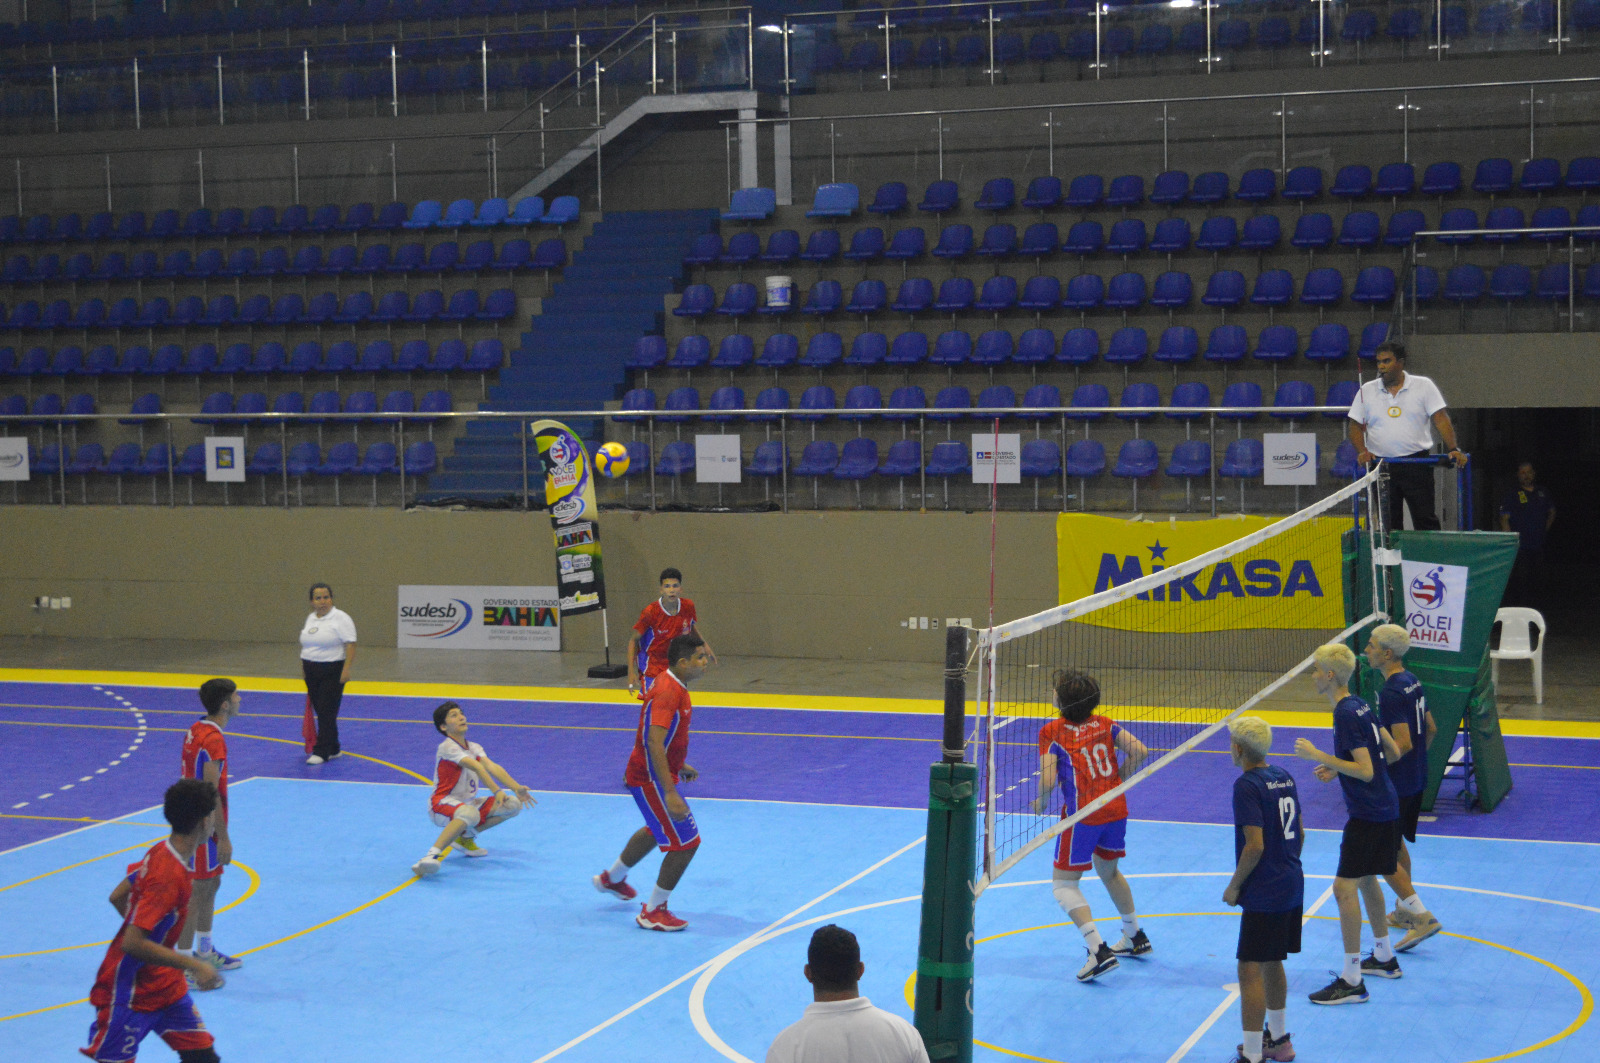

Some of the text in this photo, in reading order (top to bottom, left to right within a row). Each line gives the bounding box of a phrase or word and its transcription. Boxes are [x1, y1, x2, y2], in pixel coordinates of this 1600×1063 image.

[1272, 453, 1301, 461] sudesb
[400, 602, 457, 618] sudesb
[483, 598, 518, 606] GOVERNO
[531, 599, 559, 607] ESTADO
[1409, 628, 1449, 644] AHIA
[1080, 743, 1113, 780] 10
[469, 779, 477, 794] 9
[1278, 796, 1296, 840] 12
[121, 1035, 136, 1055] 2
